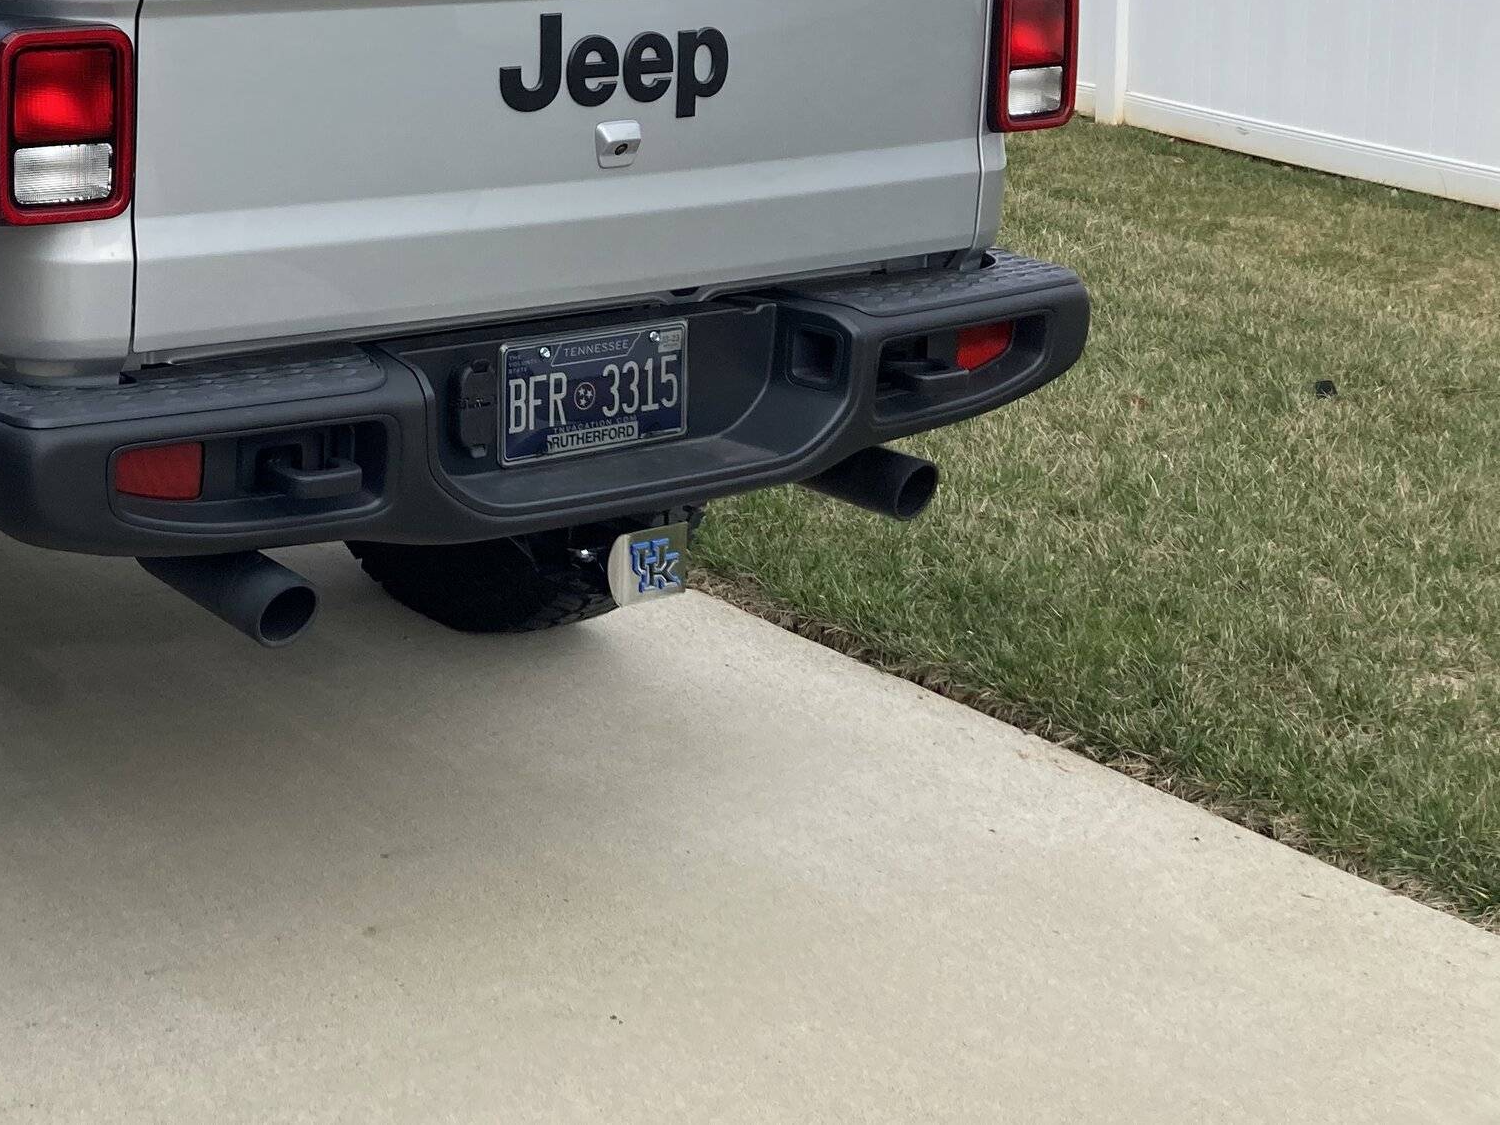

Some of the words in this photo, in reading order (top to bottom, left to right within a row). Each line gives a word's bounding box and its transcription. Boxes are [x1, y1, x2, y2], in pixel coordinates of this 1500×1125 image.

[500, 12, 729, 118] Jeep
[563, 339, 630, 357] TENNESSEE
[508, 372, 568, 434] BFR
[602, 355, 678, 417] 3315
[552, 425, 635, 449] RUTHERFORD
